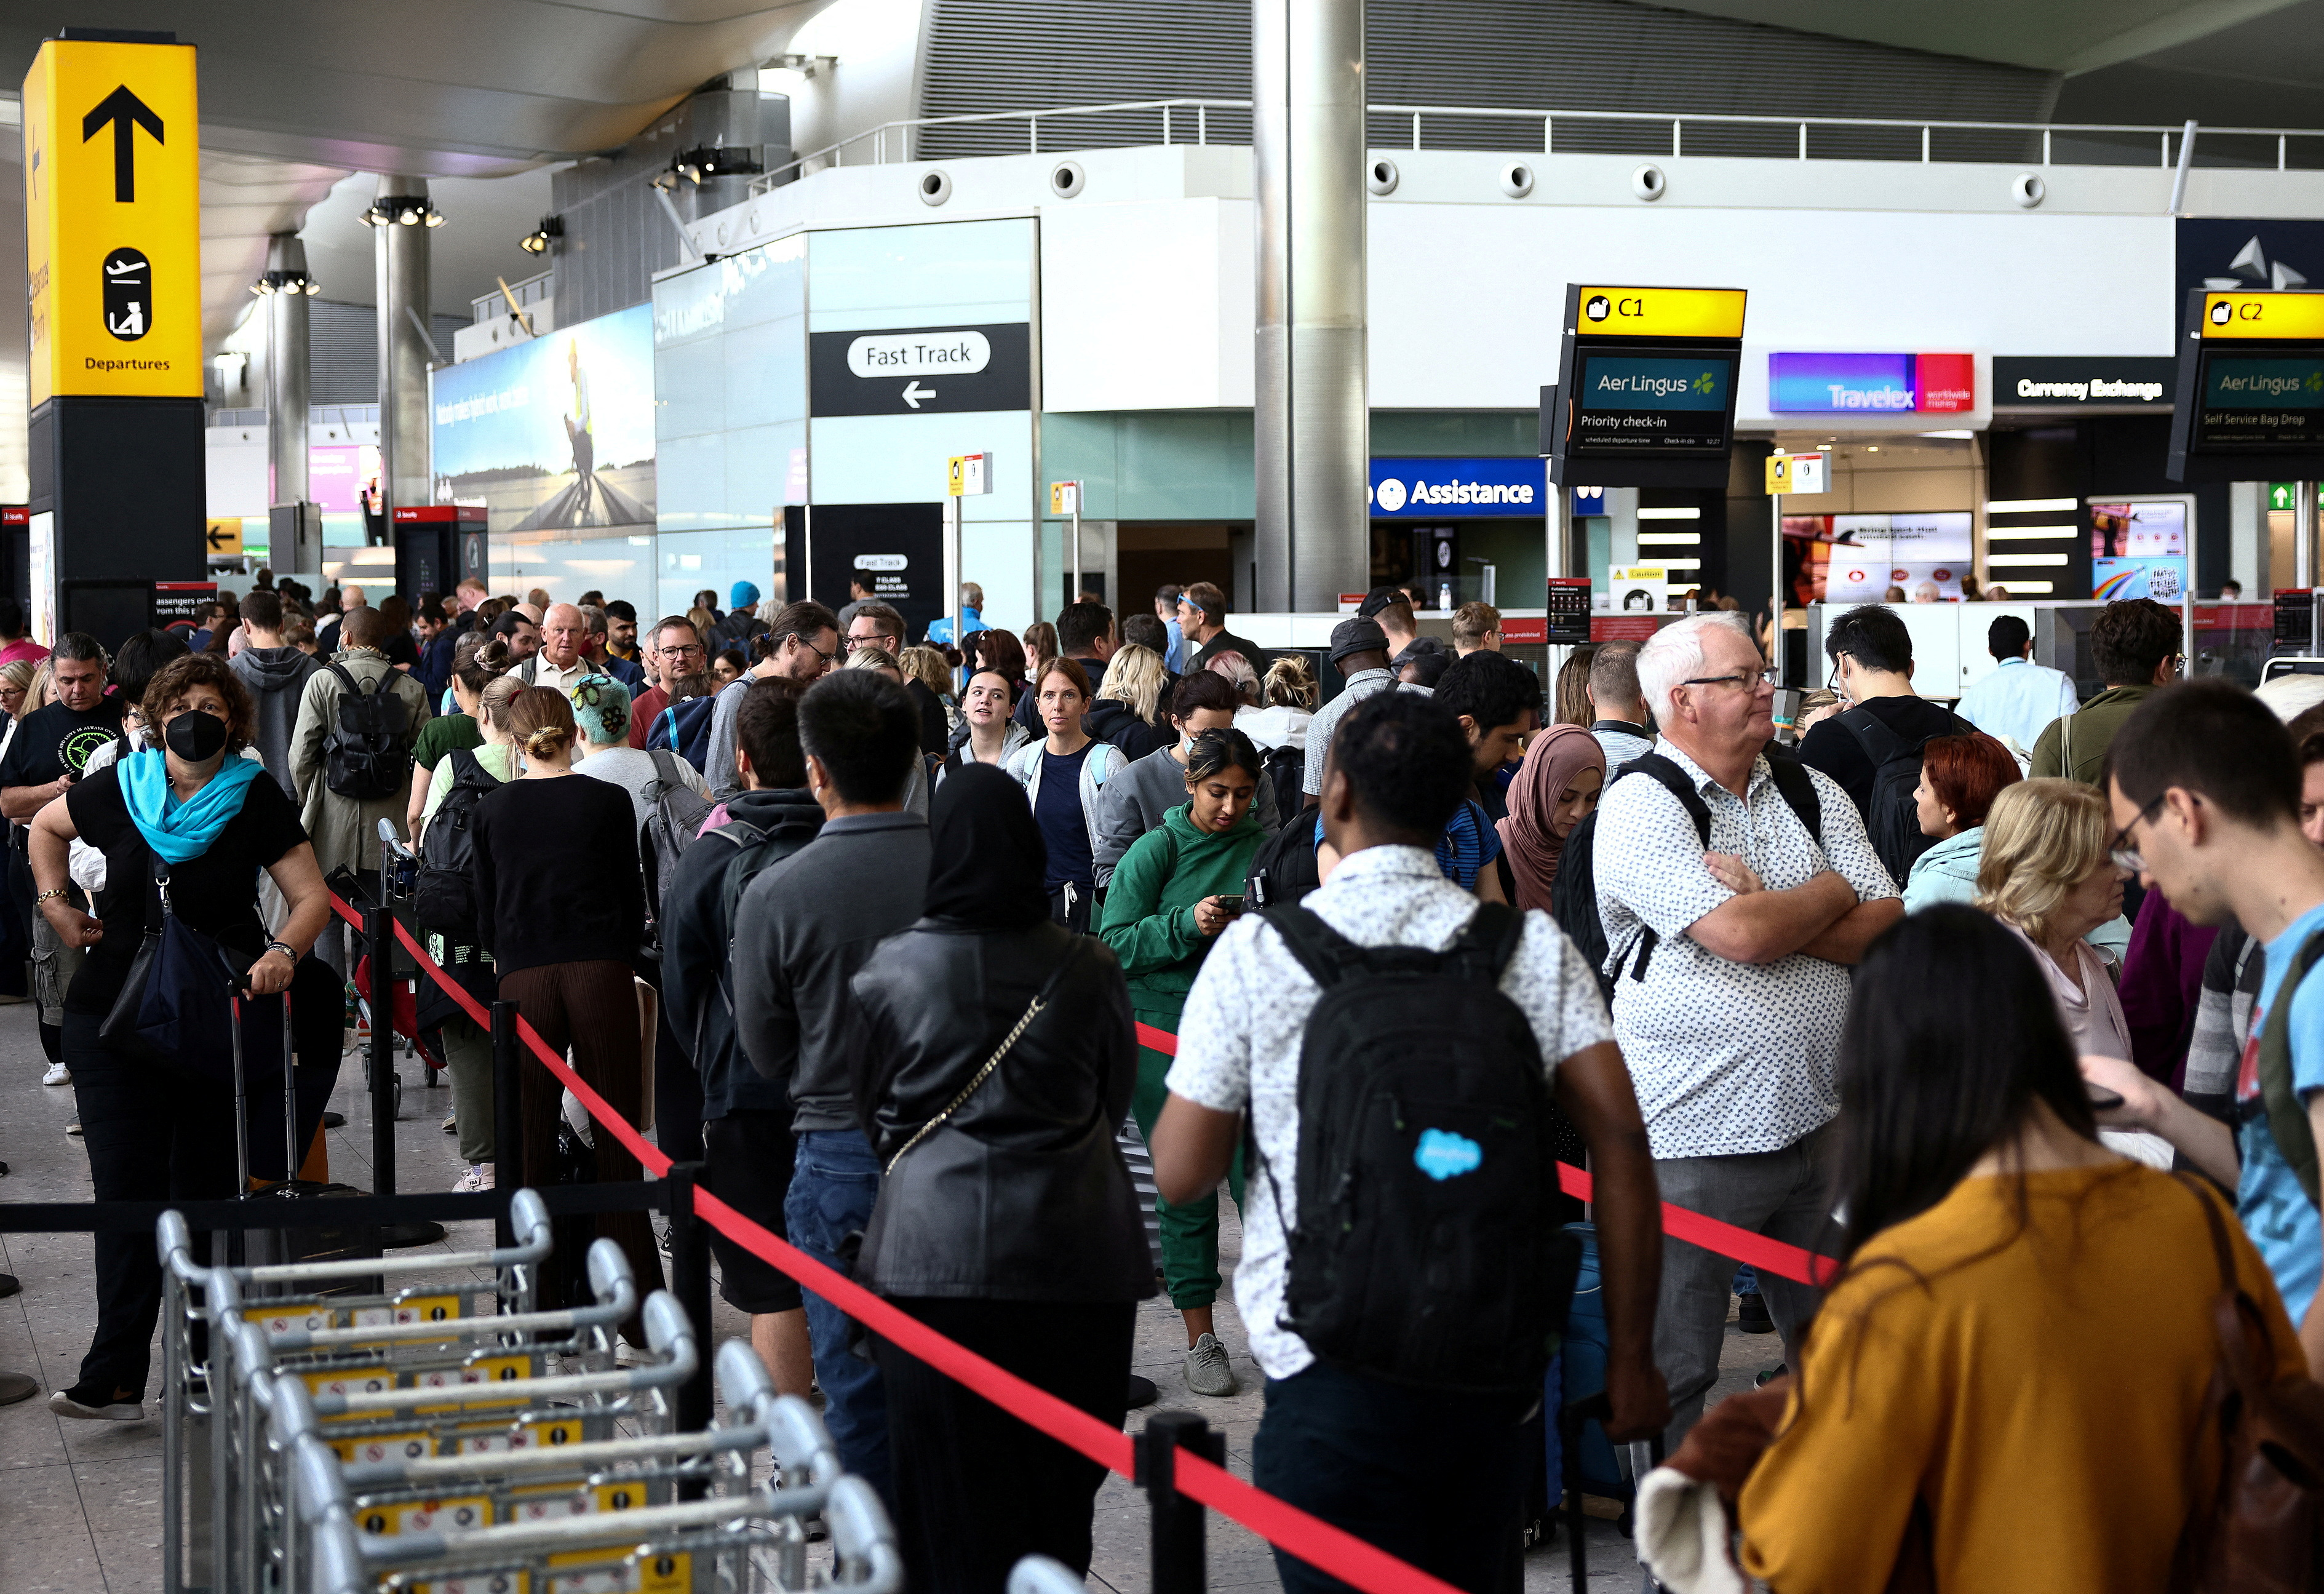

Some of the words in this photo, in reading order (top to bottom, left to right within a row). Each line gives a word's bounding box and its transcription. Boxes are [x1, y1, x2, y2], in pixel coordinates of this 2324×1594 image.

[1618, 298, 1644, 316] C1
[2240, 303, 2262, 320] C2
[867, 348, 908, 365] Fast
[915, 342, 971, 363] Track
[85, 357, 170, 372] Departures
[1598, 375, 1630, 391] Aer
[1631, 375, 1687, 397] Lingus
[2017, 378, 2088, 400] Currency
[2090, 378, 2163, 401] Exchange
[2219, 375, 2248, 391] Aer
[2250, 375, 2300, 396] Lingus
[1828, 385, 1915, 408] Travelex
[1927, 388, 1971, 400] worldwide
[1927, 400, 1958, 410] money
[1582, 415, 1620, 429] Priority
[1623, 415, 1667, 428] check-in
[2204, 413, 2222, 424] Self
[2225, 413, 2258, 425] Service
[2259, 414, 2278, 427] Bag
[2280, 414, 2305, 426] Drop
[1411, 479, 1534, 504] Assistance
[861, 558, 878, 567] Fast
[880, 557, 901, 566] Track
[156, 597, 196, 607] assengers
[156, 606, 173, 615] rom
[175, 606, 190, 615] this
[65, 730, 77, 739] LOVE
[104, 728, 117, 738] OVER
